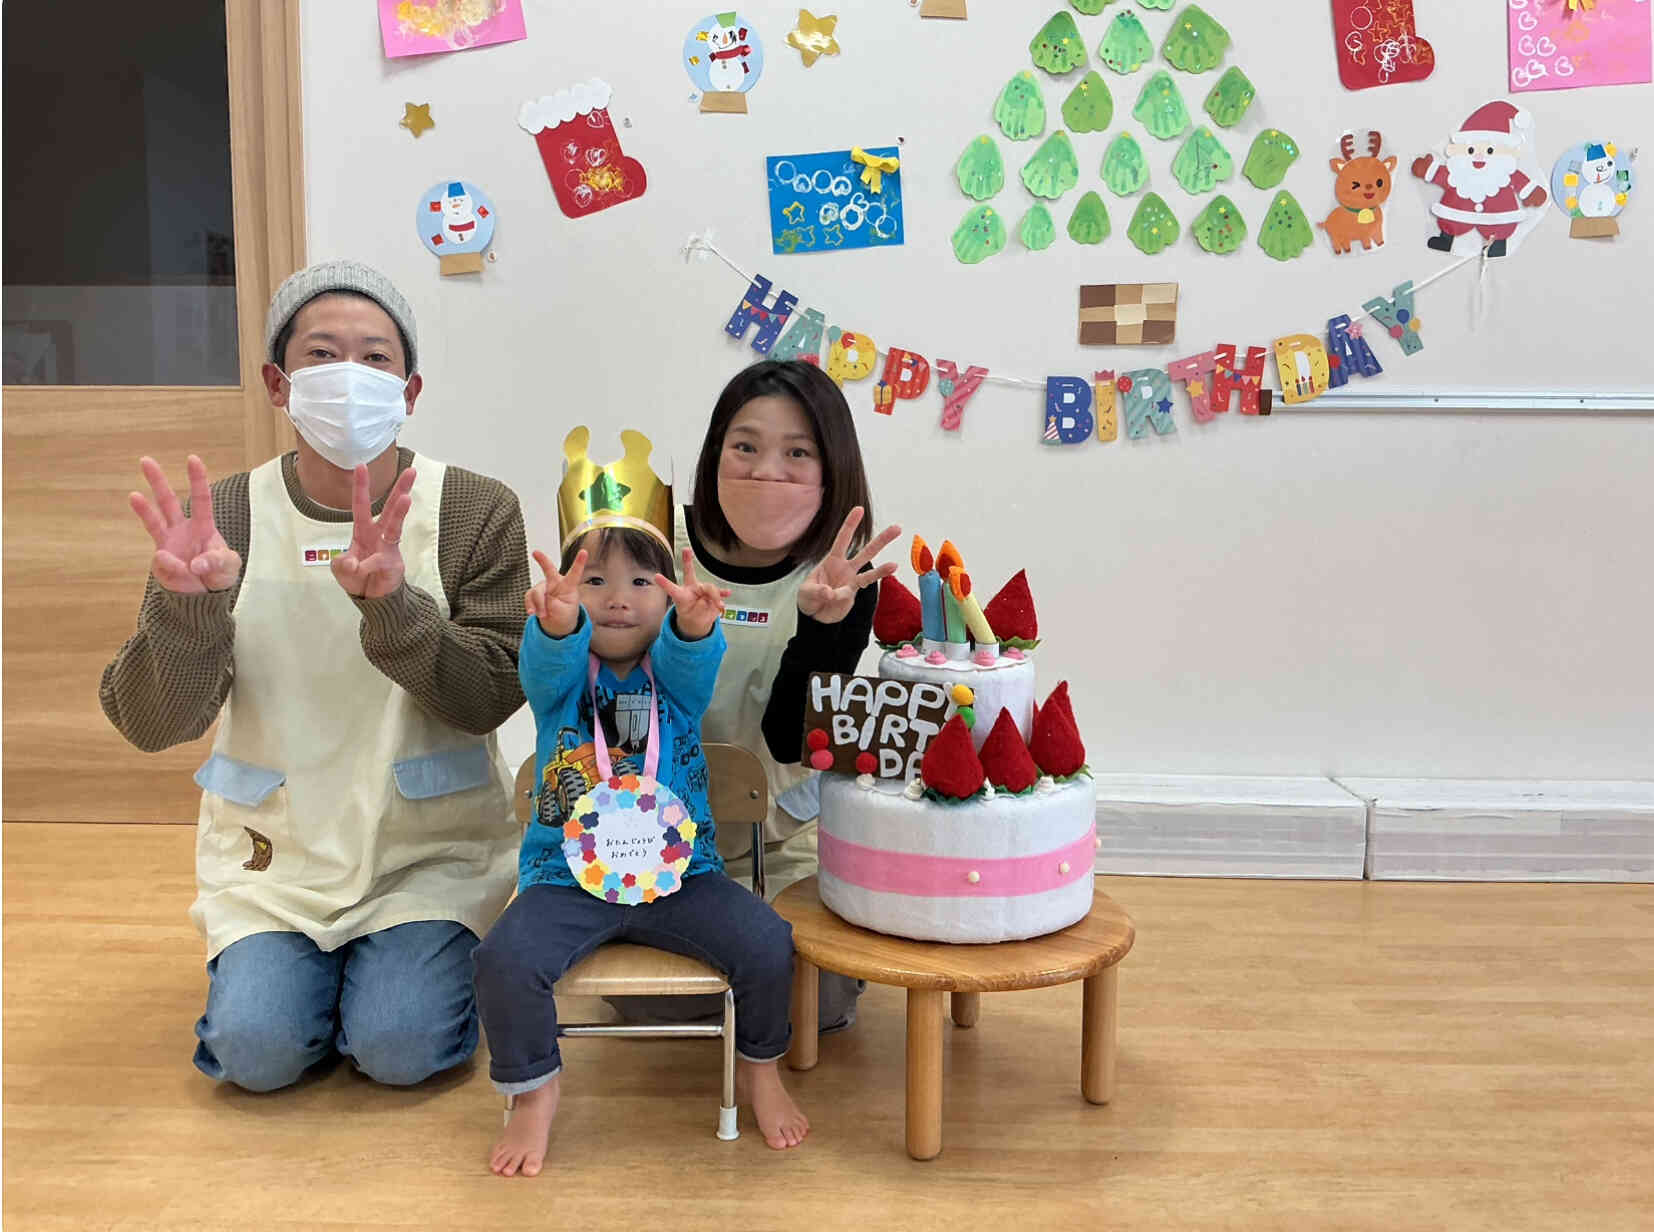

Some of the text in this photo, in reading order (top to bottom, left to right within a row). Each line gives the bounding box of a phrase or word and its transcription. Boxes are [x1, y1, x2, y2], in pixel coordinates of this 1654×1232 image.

[725, 274, 989, 431] HAPPY
[1041, 280, 1424, 445] BIRTHDAY
[832, 714, 945, 752] BIRT
[879, 749, 925, 785] DA
